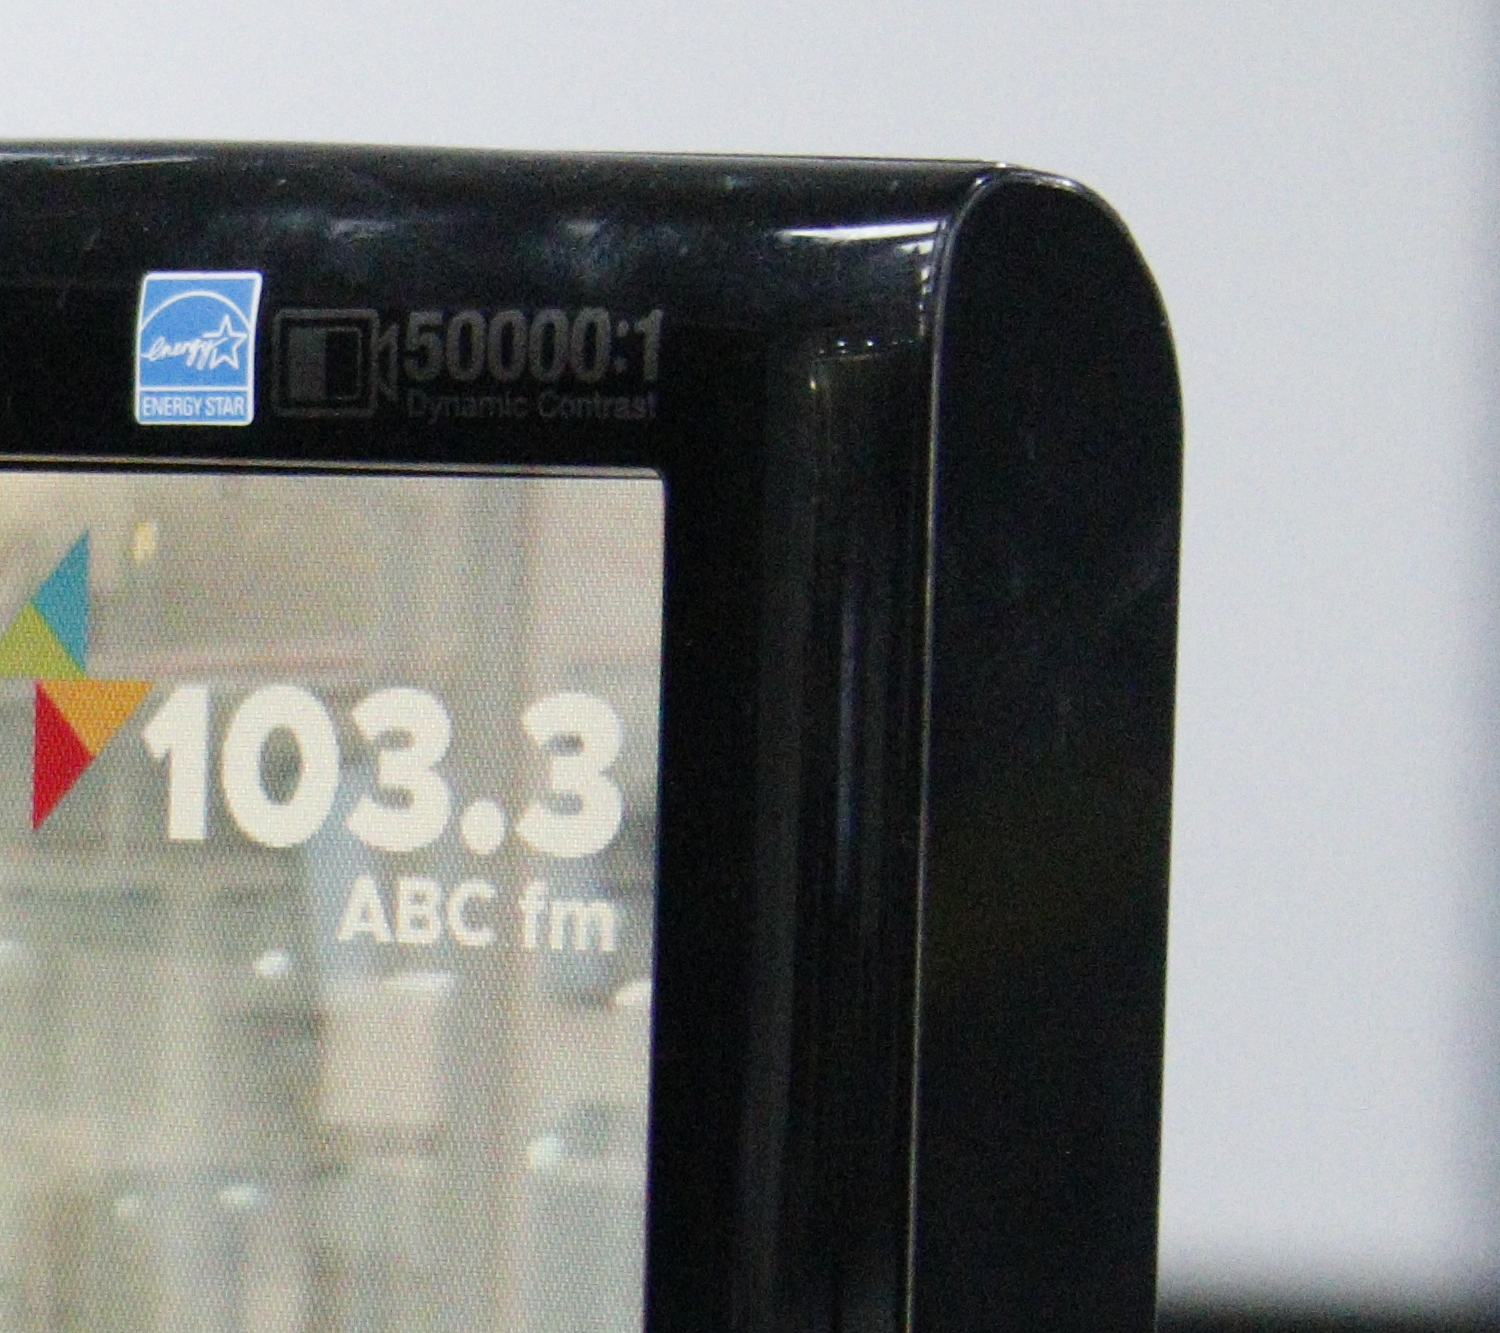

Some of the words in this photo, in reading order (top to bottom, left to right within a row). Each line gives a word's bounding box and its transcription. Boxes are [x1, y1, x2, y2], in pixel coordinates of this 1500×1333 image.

[404, 309, 664, 383] 50000:1
[142, 396, 201, 417] ENERGY
[204, 397, 246, 417] STAR
[408, 391, 529, 421] Dynamic
[538, 391, 658, 421] Contrast
[141, 682, 624, 858] 103.3
[338, 876, 498, 946] ABC
[518, 879, 618, 952] fm
